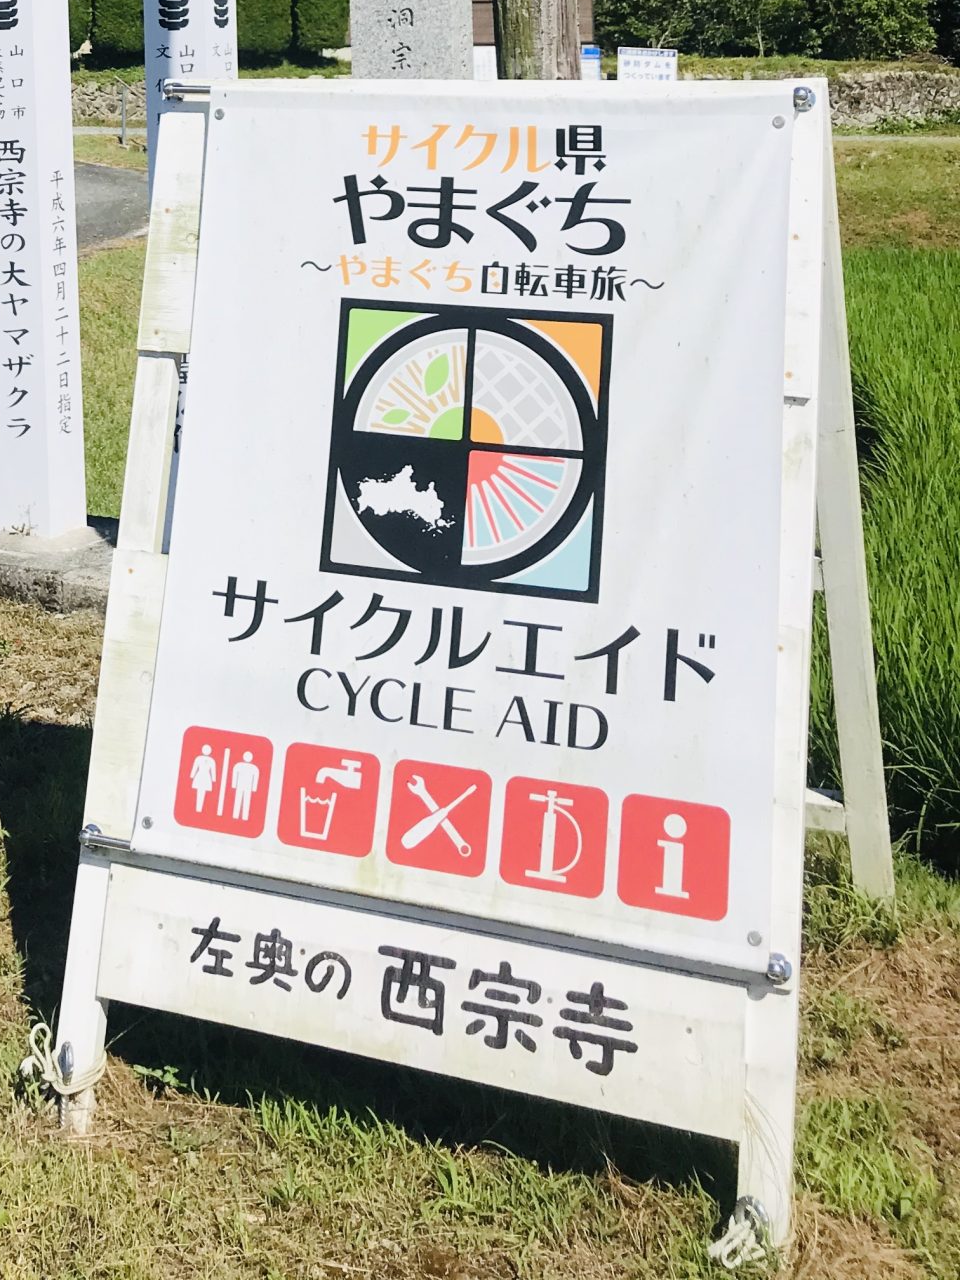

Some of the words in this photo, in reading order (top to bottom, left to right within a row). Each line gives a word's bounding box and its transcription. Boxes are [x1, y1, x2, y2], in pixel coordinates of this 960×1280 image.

[9, 44, 27, 120] 山口市
[361, 123, 607, 176] サイクル県
[332, 173, 632, 256] やまぐち
[49, 169, 73, 435] 平成六年四月二十二日指定
[212, 575, 718, 702] サイクルエイド
[296, 667, 475, 734] CYCLE
[495, 695, 610, 752] AID
[190, 916, 352, 1001] 左奥の
[377, 944, 639, 1077] 西宗寺
